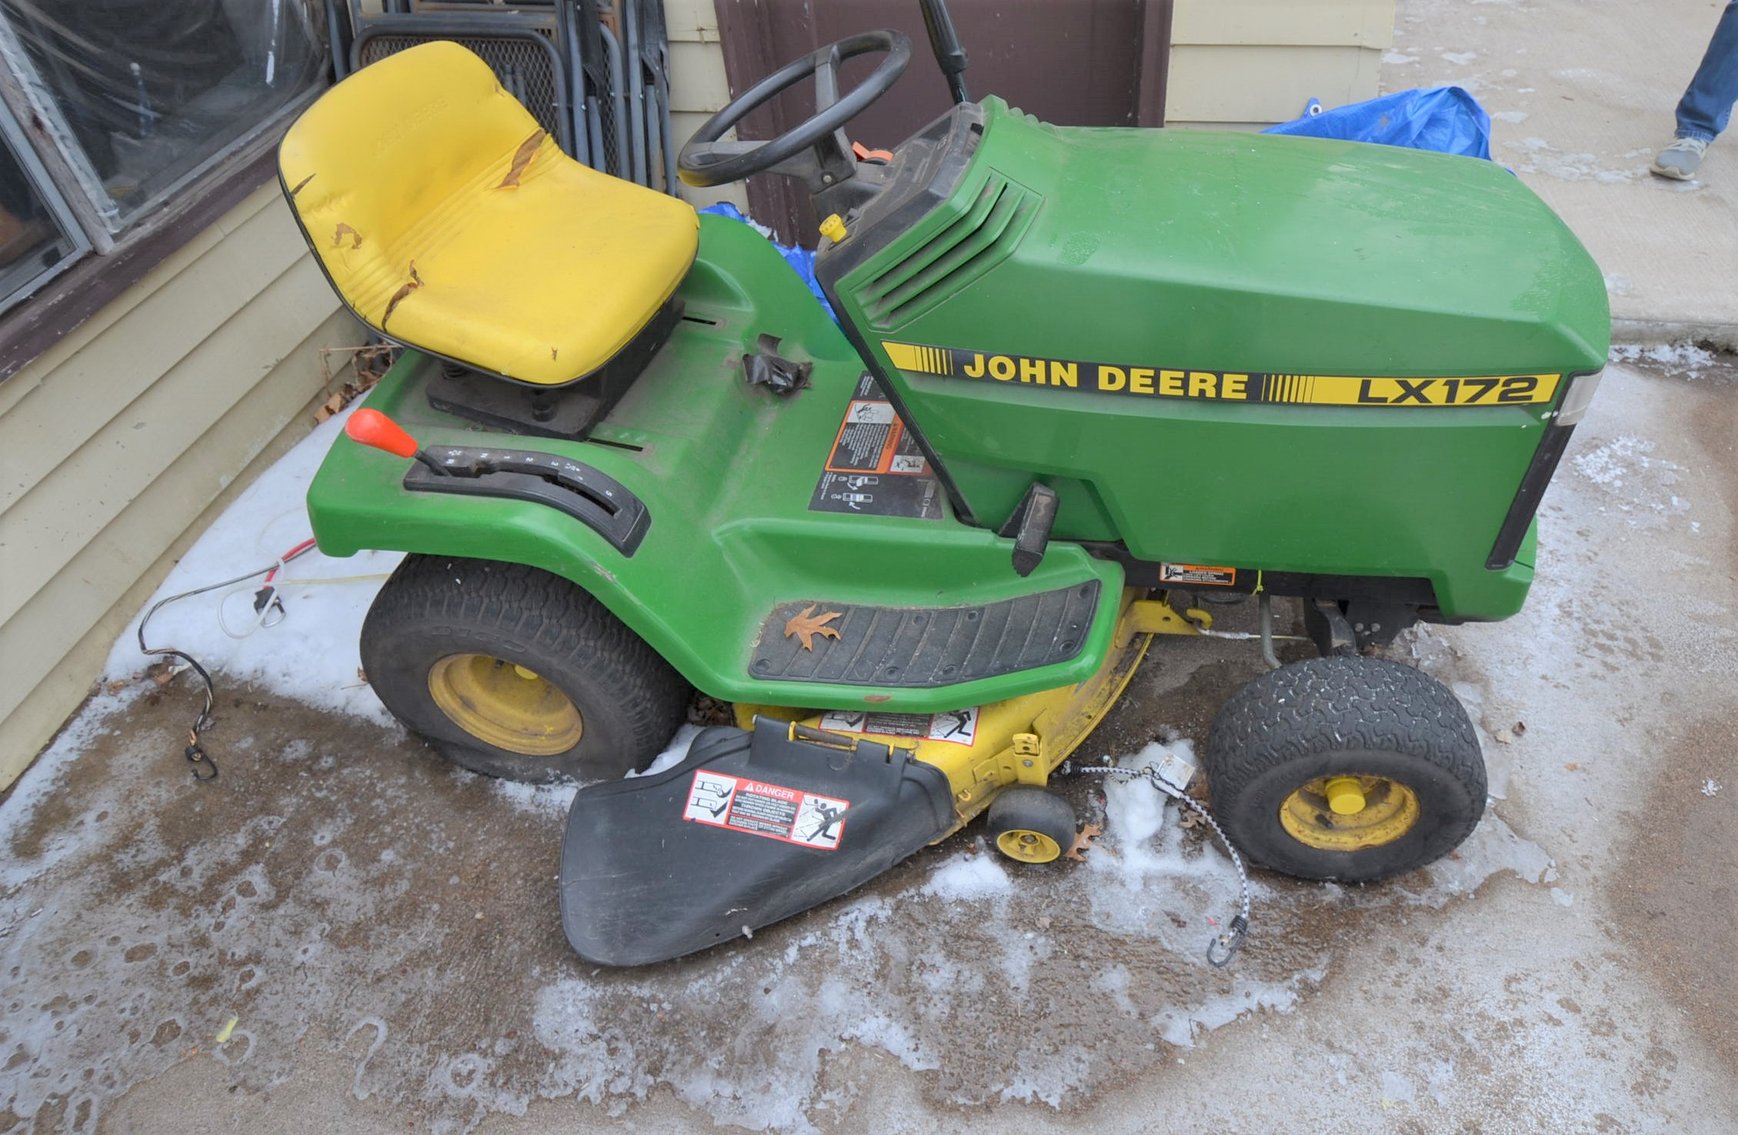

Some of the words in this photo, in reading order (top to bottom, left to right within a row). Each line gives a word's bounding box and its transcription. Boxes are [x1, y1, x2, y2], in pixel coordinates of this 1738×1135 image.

[964, 353, 1078, 388] JOHN
[1098, 365, 1249, 400] DEERE
[1357, 376, 1539, 404] LX172
[754, 784, 795, 800] DANGER
